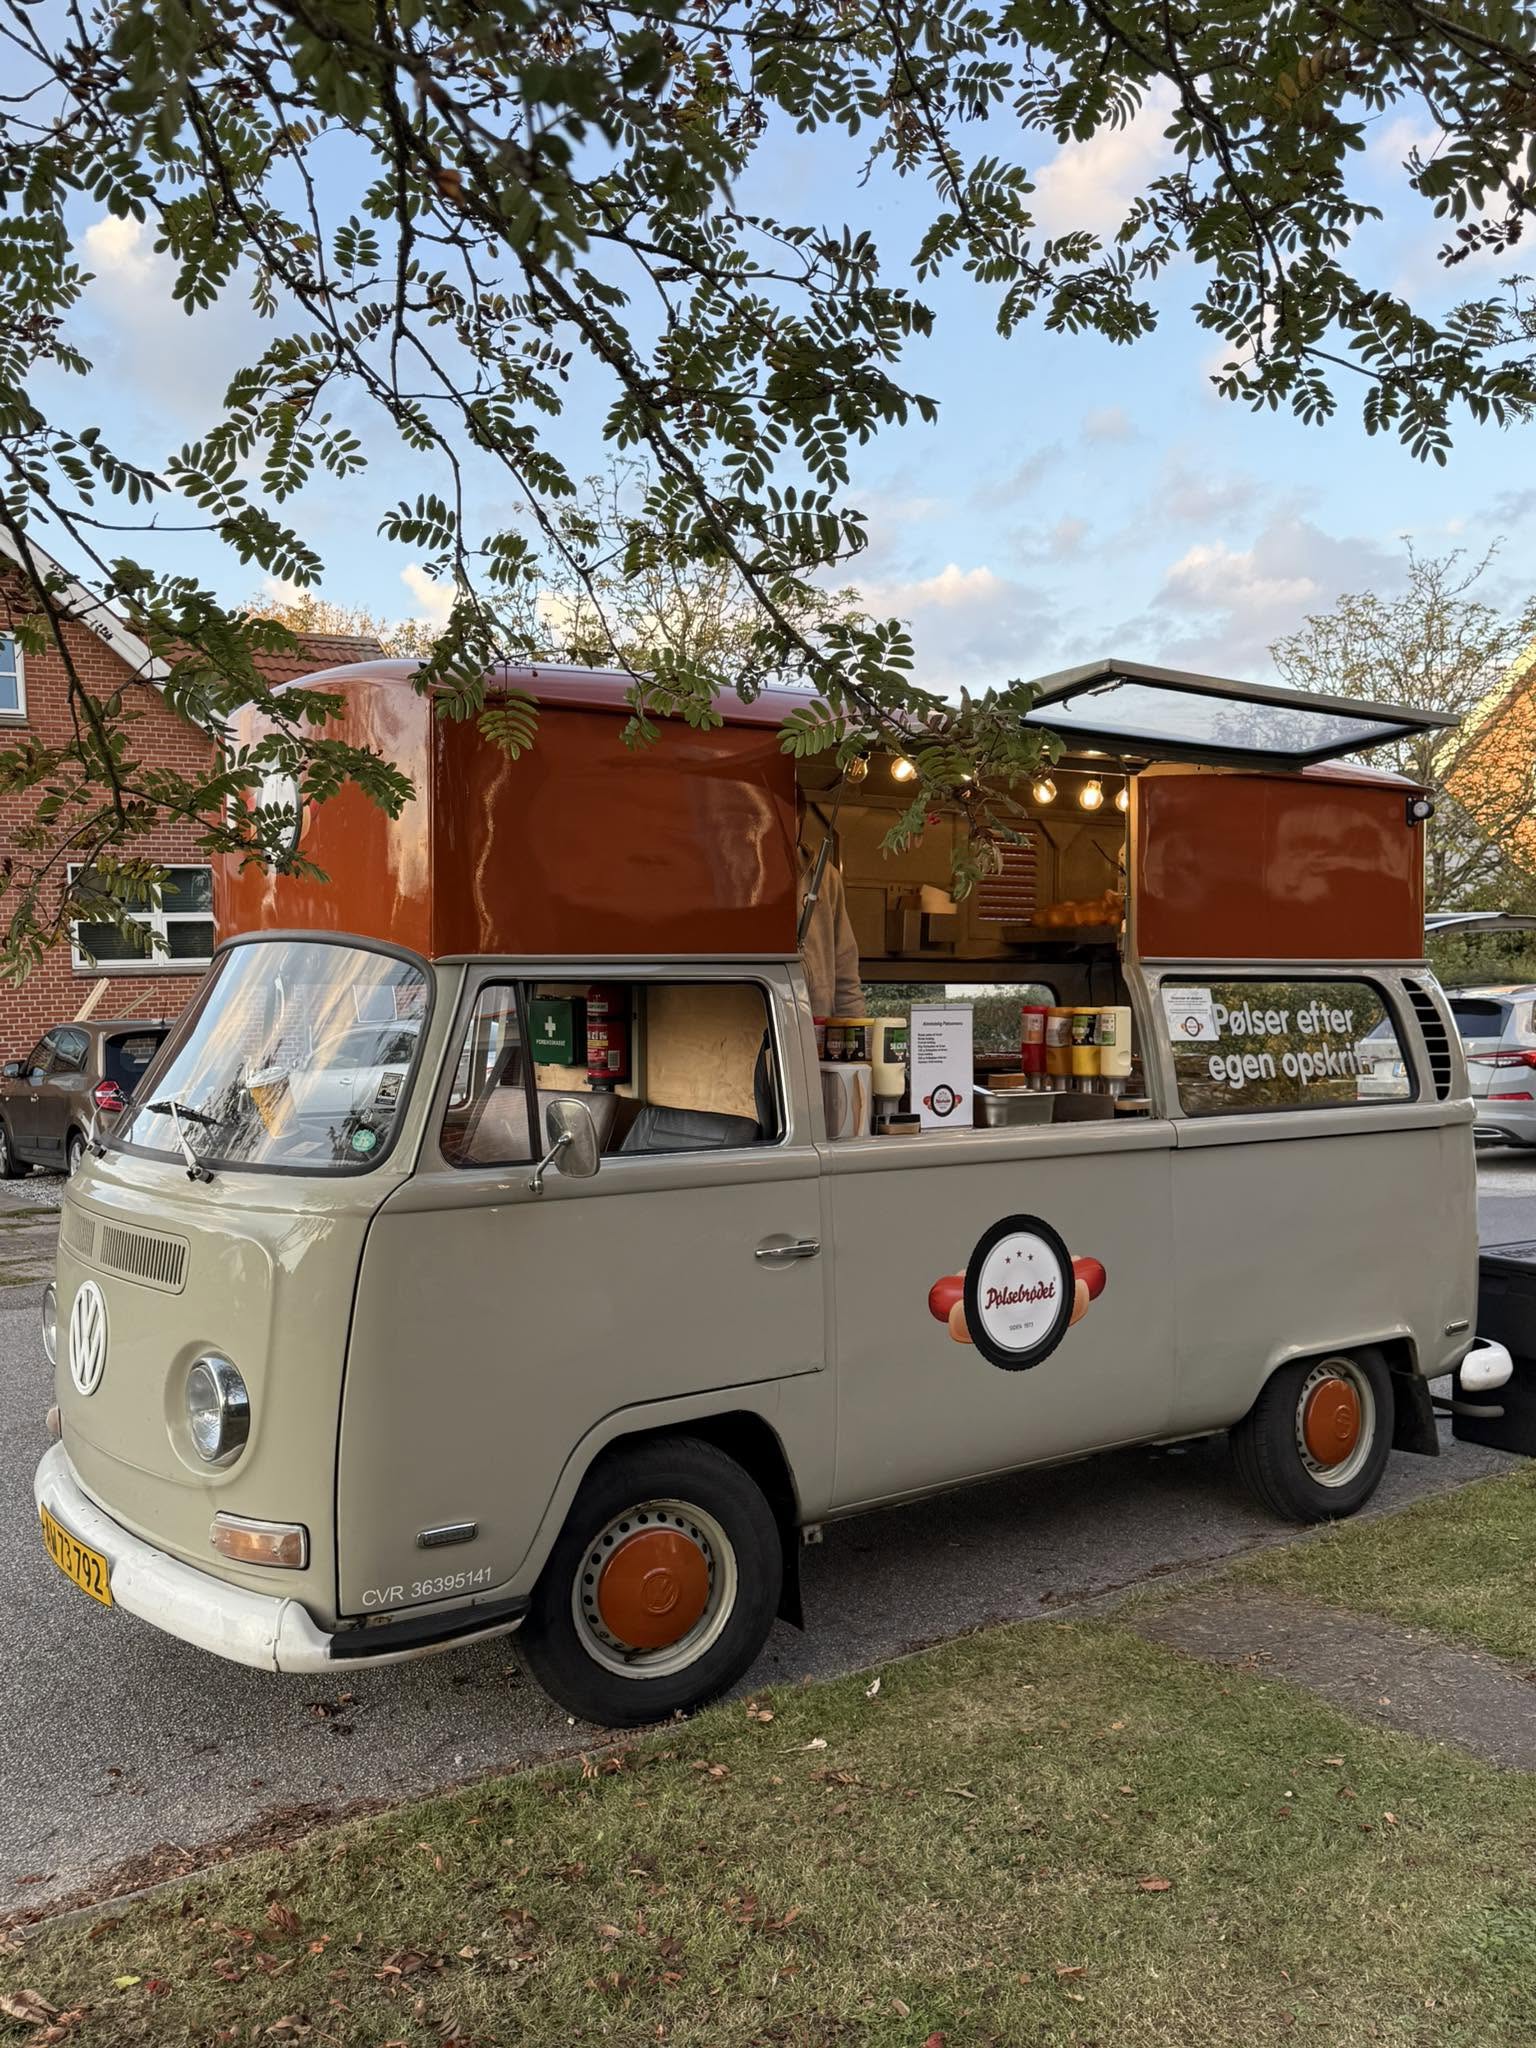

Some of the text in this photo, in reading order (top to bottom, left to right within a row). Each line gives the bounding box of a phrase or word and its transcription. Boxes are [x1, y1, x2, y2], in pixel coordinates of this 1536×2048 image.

[1212, 1001, 1290, 1036] Pølser
[1296, 1000, 1354, 1034] efter
[1208, 1050, 1276, 1090] egen
[985, 1280, 1056, 1310] Pølsebrødet
[362, 1566, 492, 1606] CVR 36395141
